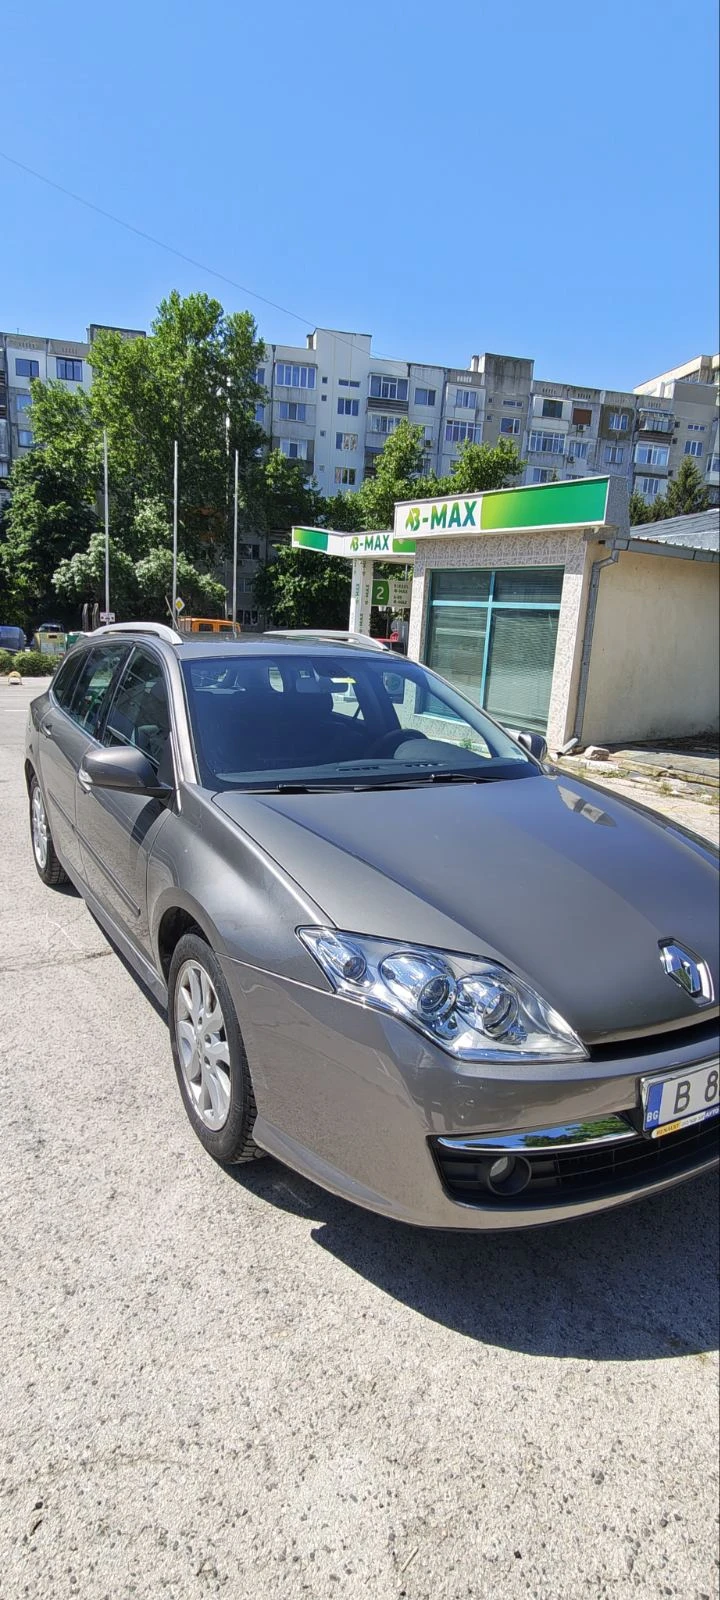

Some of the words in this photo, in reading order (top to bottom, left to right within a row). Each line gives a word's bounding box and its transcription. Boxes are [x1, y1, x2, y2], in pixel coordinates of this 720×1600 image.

[405, 501, 477, 531] B-MAX
[350, 535, 389, 551] B-MAX
[375, 586, 384, 600] 2
[673, 1080, 691, 1115] B
[646, 1110, 659, 1122] BG
